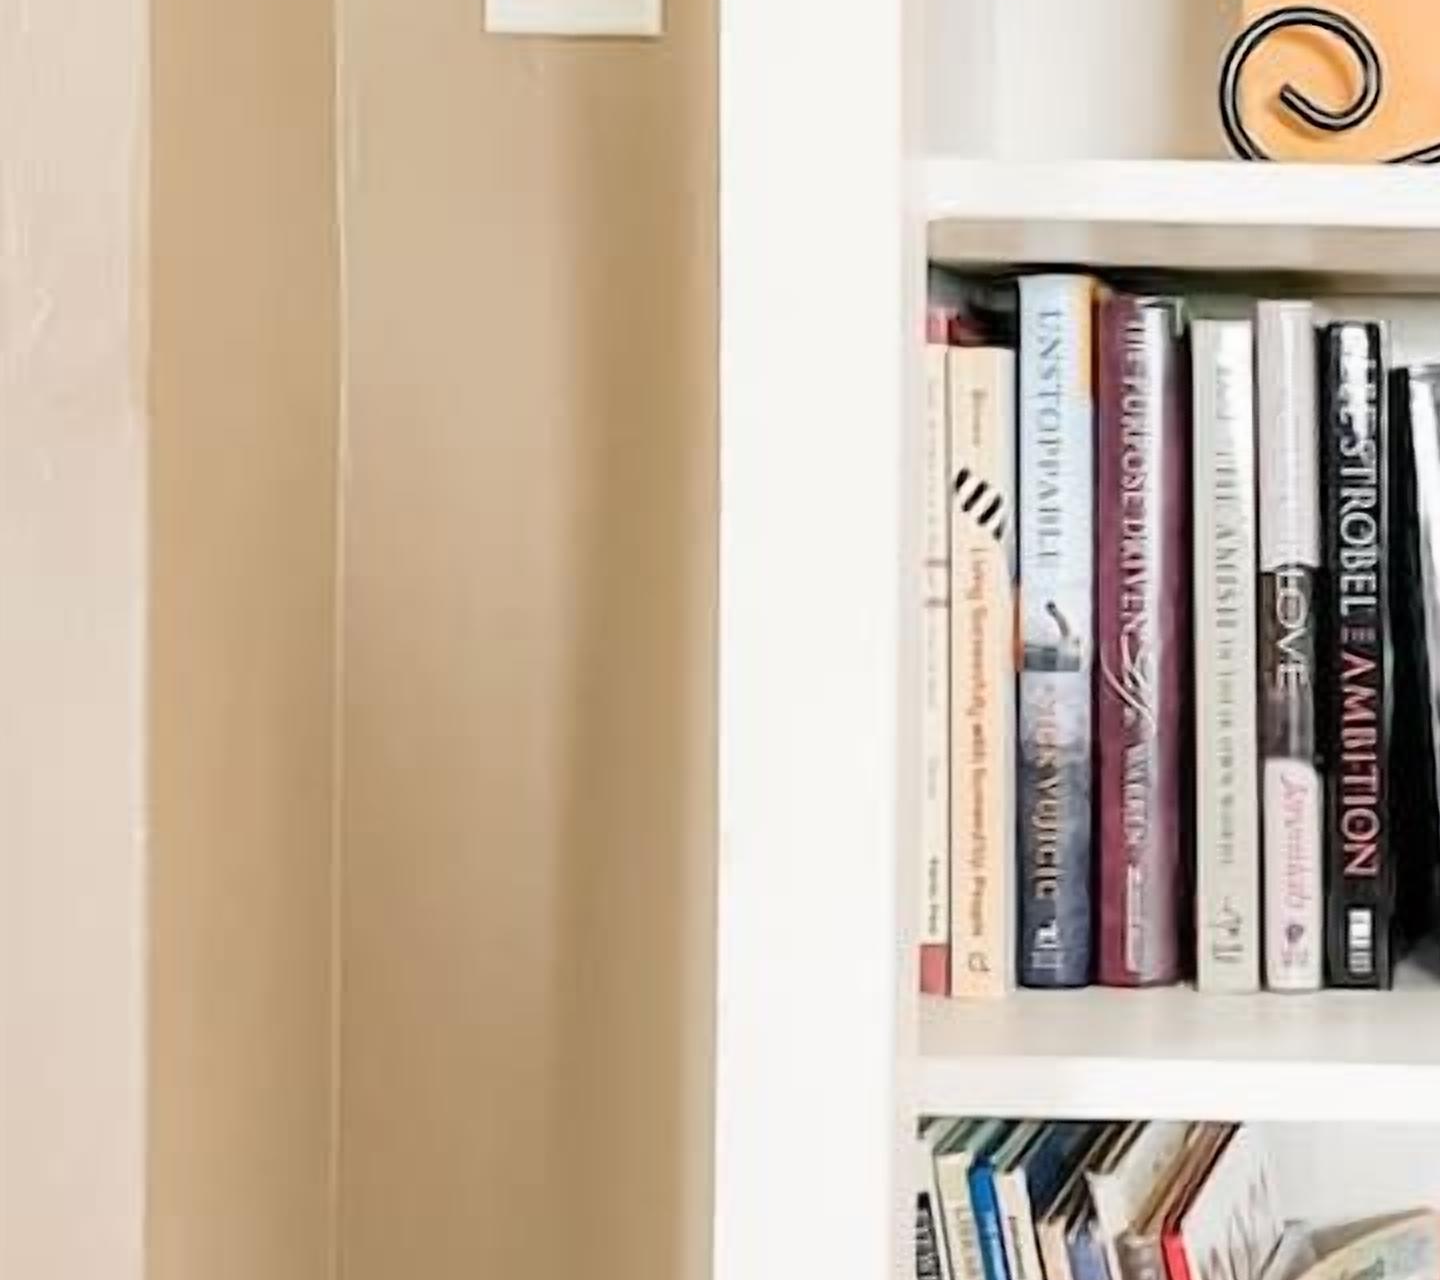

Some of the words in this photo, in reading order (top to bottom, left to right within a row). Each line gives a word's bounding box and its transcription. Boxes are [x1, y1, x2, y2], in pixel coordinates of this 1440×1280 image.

[1034, 310, 1064, 569] UNSTOPPABLE
[1119, 375, 1151, 510] PURPOSE
[1119, 518, 1151, 636] DRIVEN
[1214, 522, 1244, 630] AMISH
[1338, 439, 1378, 617] STROBEL
[1340, 651, 1380, 877] AMBITION
